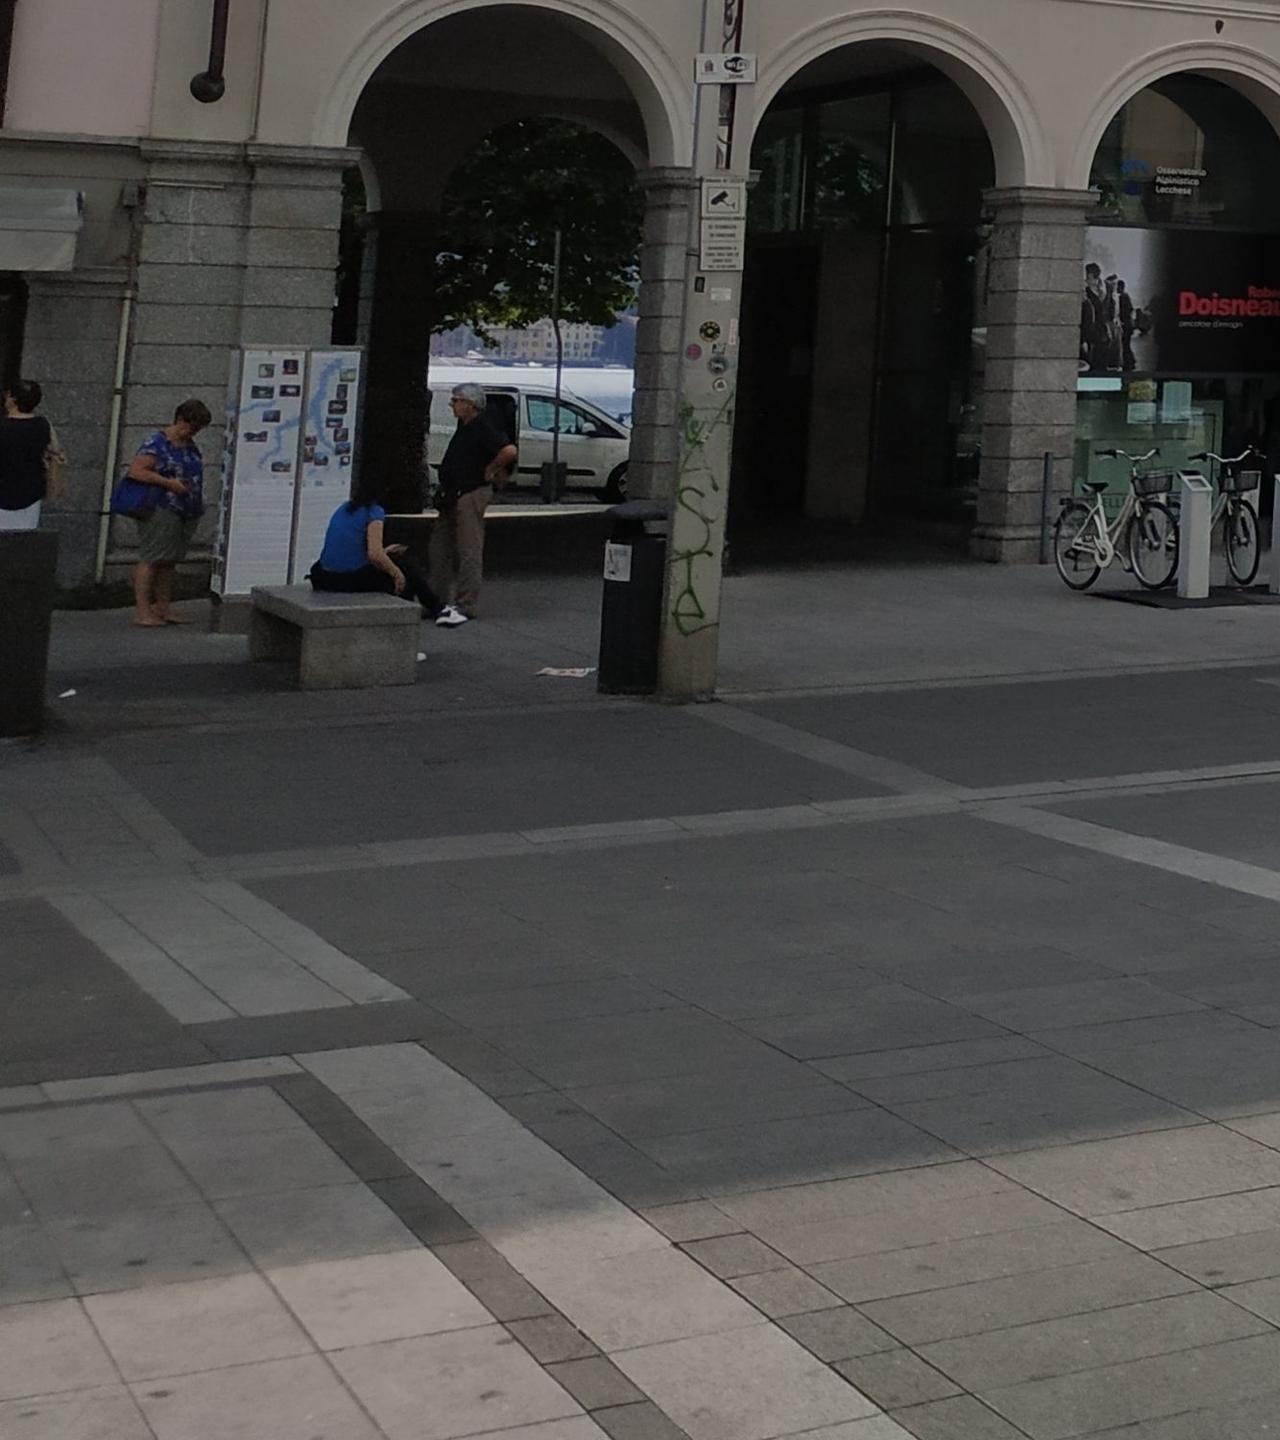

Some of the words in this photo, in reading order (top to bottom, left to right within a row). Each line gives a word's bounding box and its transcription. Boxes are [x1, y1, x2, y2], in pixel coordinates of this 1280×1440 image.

[1156, 166, 1207, 176] Osservatorio
[1156, 176, 1200, 187] Alpinistico
[1156, 186, 1192, 195] Lecchese
